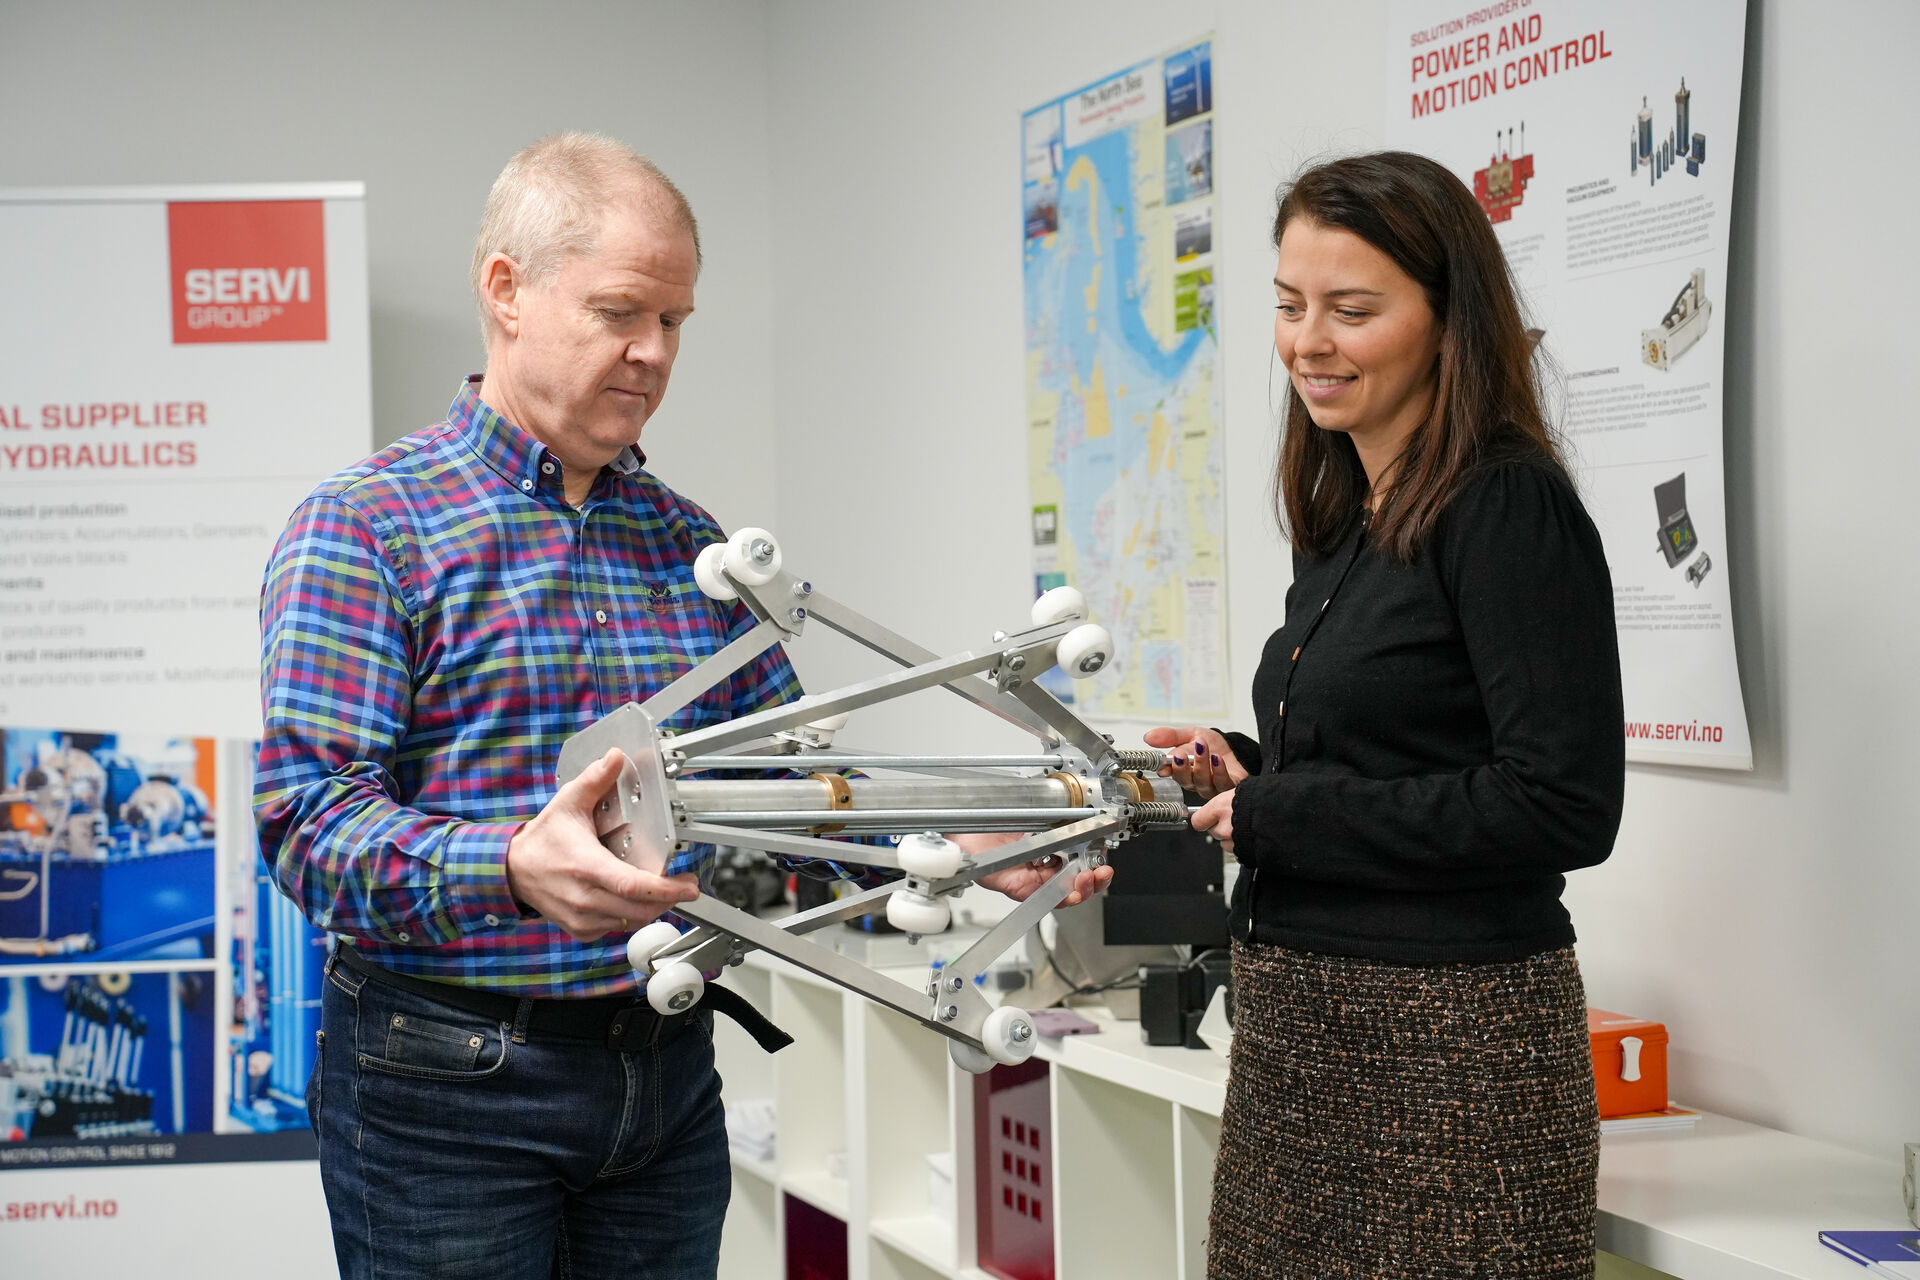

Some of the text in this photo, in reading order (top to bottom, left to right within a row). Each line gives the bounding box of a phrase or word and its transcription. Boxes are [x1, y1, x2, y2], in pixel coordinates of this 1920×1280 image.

[1410, 18, 1464, 47] SOLUTION
[1466, 0, 1519, 28] PROVIDER
[1412, 13, 1542, 83] POWER AND
[1412, 30, 1613, 120] MOTION CONTROL
[185, 266, 311, 304] SERVI
[41, 401, 207, 430] SUPPLIER
[0, 442, 198, 471] YDRAULICS
[1624, 720, 1723, 743] ww.servi.no
[52, 1145, 107, 1162] CONTROL
[109, 1143, 147, 1160] SINCE
